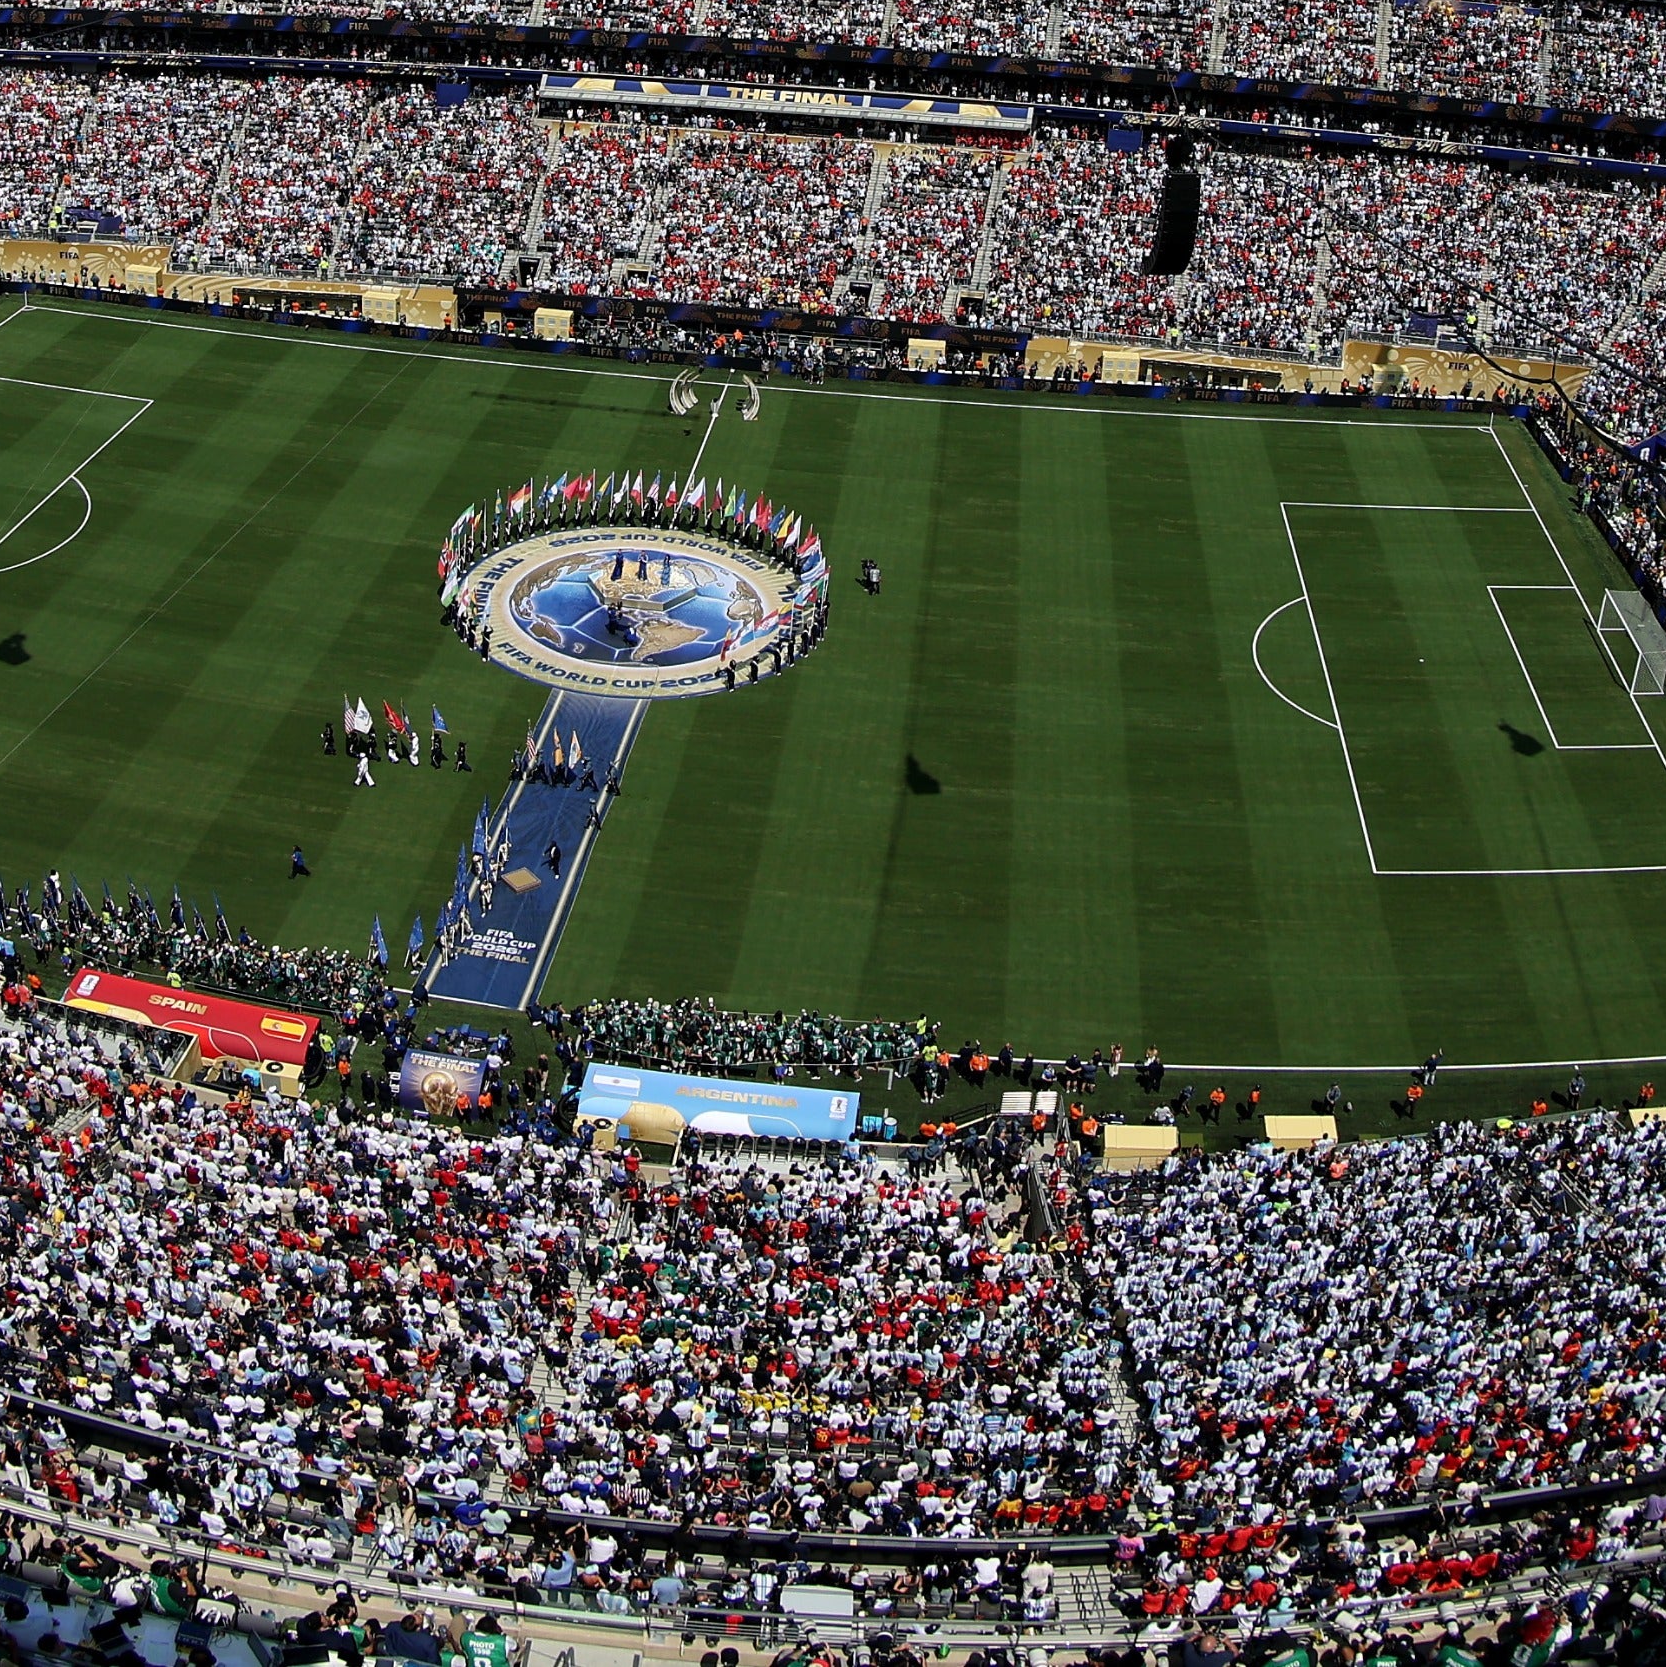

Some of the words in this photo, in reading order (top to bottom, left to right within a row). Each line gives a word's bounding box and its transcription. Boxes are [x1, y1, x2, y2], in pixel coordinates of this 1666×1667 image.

[64, 13, 84, 21] FIFA
[142, 15, 162, 23] THE
[164, 16, 192, 24] FINAL
[254, 19, 274, 27] FIFA
[349, 22, 369, 31] FIFA
[433, 26, 454, 34] THE
[455, 27, 485, 36] FINAL
[549, 32, 570, 40] FIFA
[648, 37, 669, 46] FIFA
[732, 43, 754, 51] THE
[755, 44, 787, 53] FINAL
[851, 50, 872, 59] FIFA
[951, 58, 973, 67] FIFA
[1036, 64, 1059, 74] THE
[1059, 65, 1092, 76] FINAL
[1157, 73, 1178, 83] FIFA
[1257, 83, 1280, 93] FIFA
[726, 87, 776, 101] THE
[779, 91, 852, 105] FINAL
[1343, 91, 1365, 100] THE
[1366, 93, 1398, 104] FINAL
[1463, 103, 1484, 113] FIFA
[1562, 114, 1585, 124] FIFA
[59, 251, 79, 260] FIFA
[563, 300, 583, 308] FIFA
[646, 306, 666, 314] FIFA
[817, 320, 837, 329] FIFA
[901, 328, 922, 336] FIFA
[973, 335, 992, 344] THE
[992, 336, 1019, 345] FINAL
[1448, 361, 1469, 372] FIFA
[548, 533, 616, 547] 2026
[496, 642, 533, 666] FIFA
[534, 660, 607, 685] WORLD
[610, 679, 653, 688] CUP
[485, 928, 514, 940] FIFA
[508, 939, 537, 950] CUP
[486, 951, 534, 964] FINAL
[148, 994, 207, 1015] SPAIN
[410, 1056, 438, 1067] THE
[438, 1060, 480, 1075] FINAL
[675, 1085, 799, 1107] ARGENTINA
[468, 1639, 496, 1649] PHOTO
